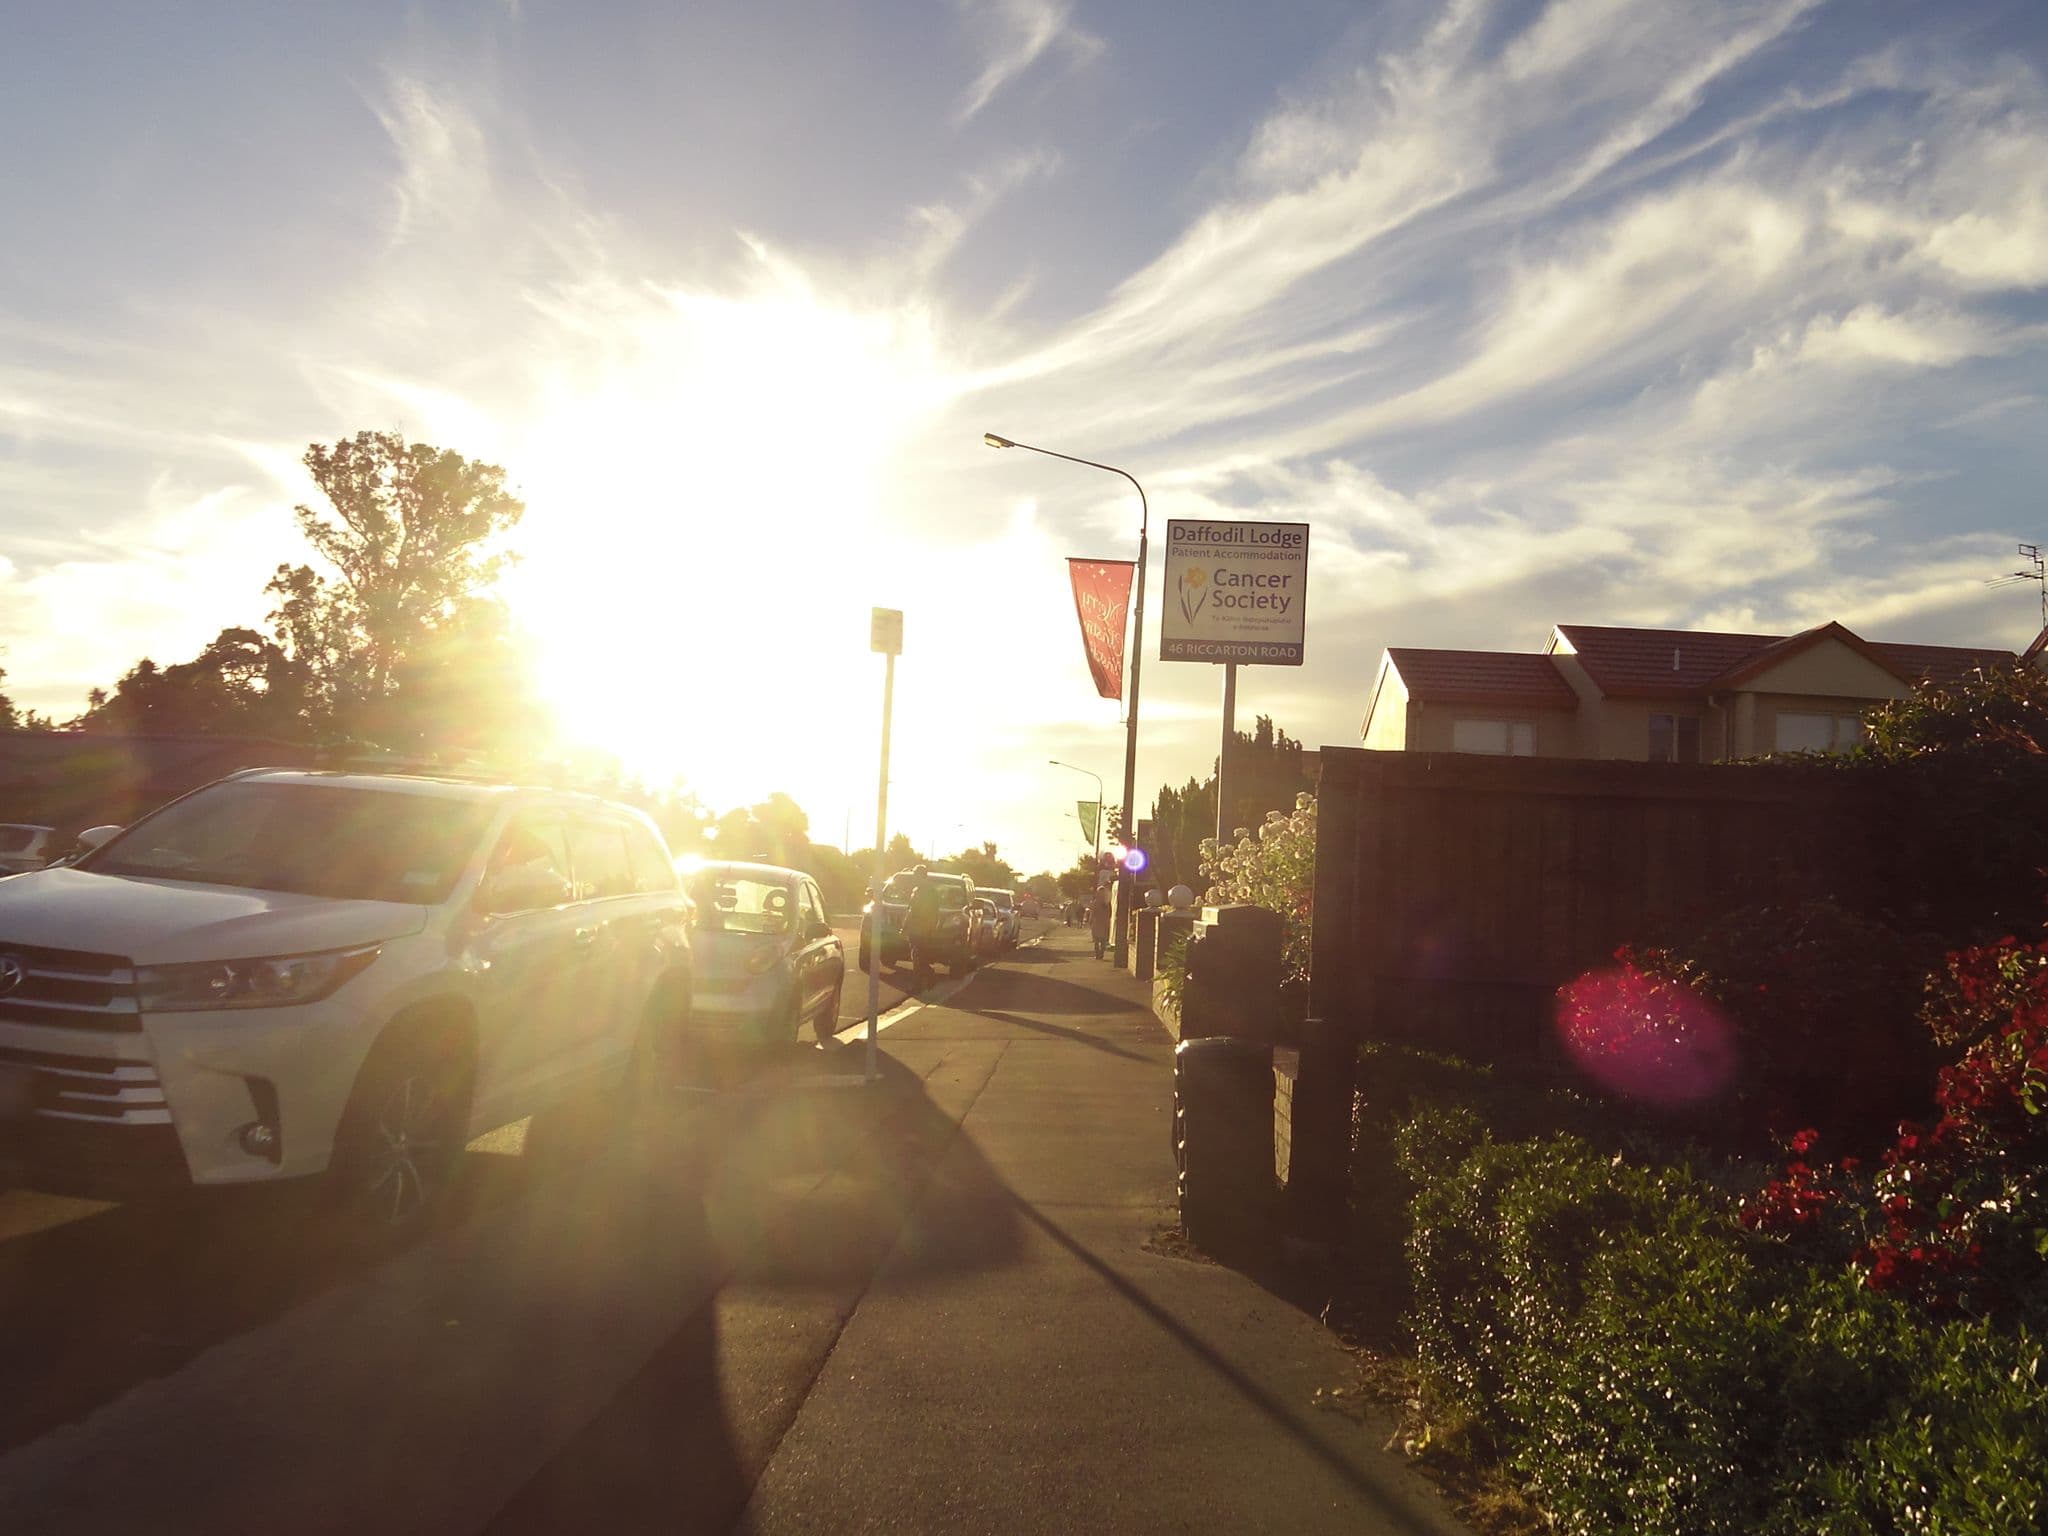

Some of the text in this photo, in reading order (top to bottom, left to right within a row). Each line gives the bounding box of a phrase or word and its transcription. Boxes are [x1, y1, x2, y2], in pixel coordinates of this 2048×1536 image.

[1172, 526, 1302, 548] Daffodil Lodge
[1172, 547, 1302, 561] Patient Accommodation
[1213, 568, 1292, 588] Cancer
[1212, 590, 1292, 614] Society
[1168, 642, 1298, 658] 46 RICCARTON ROAD
